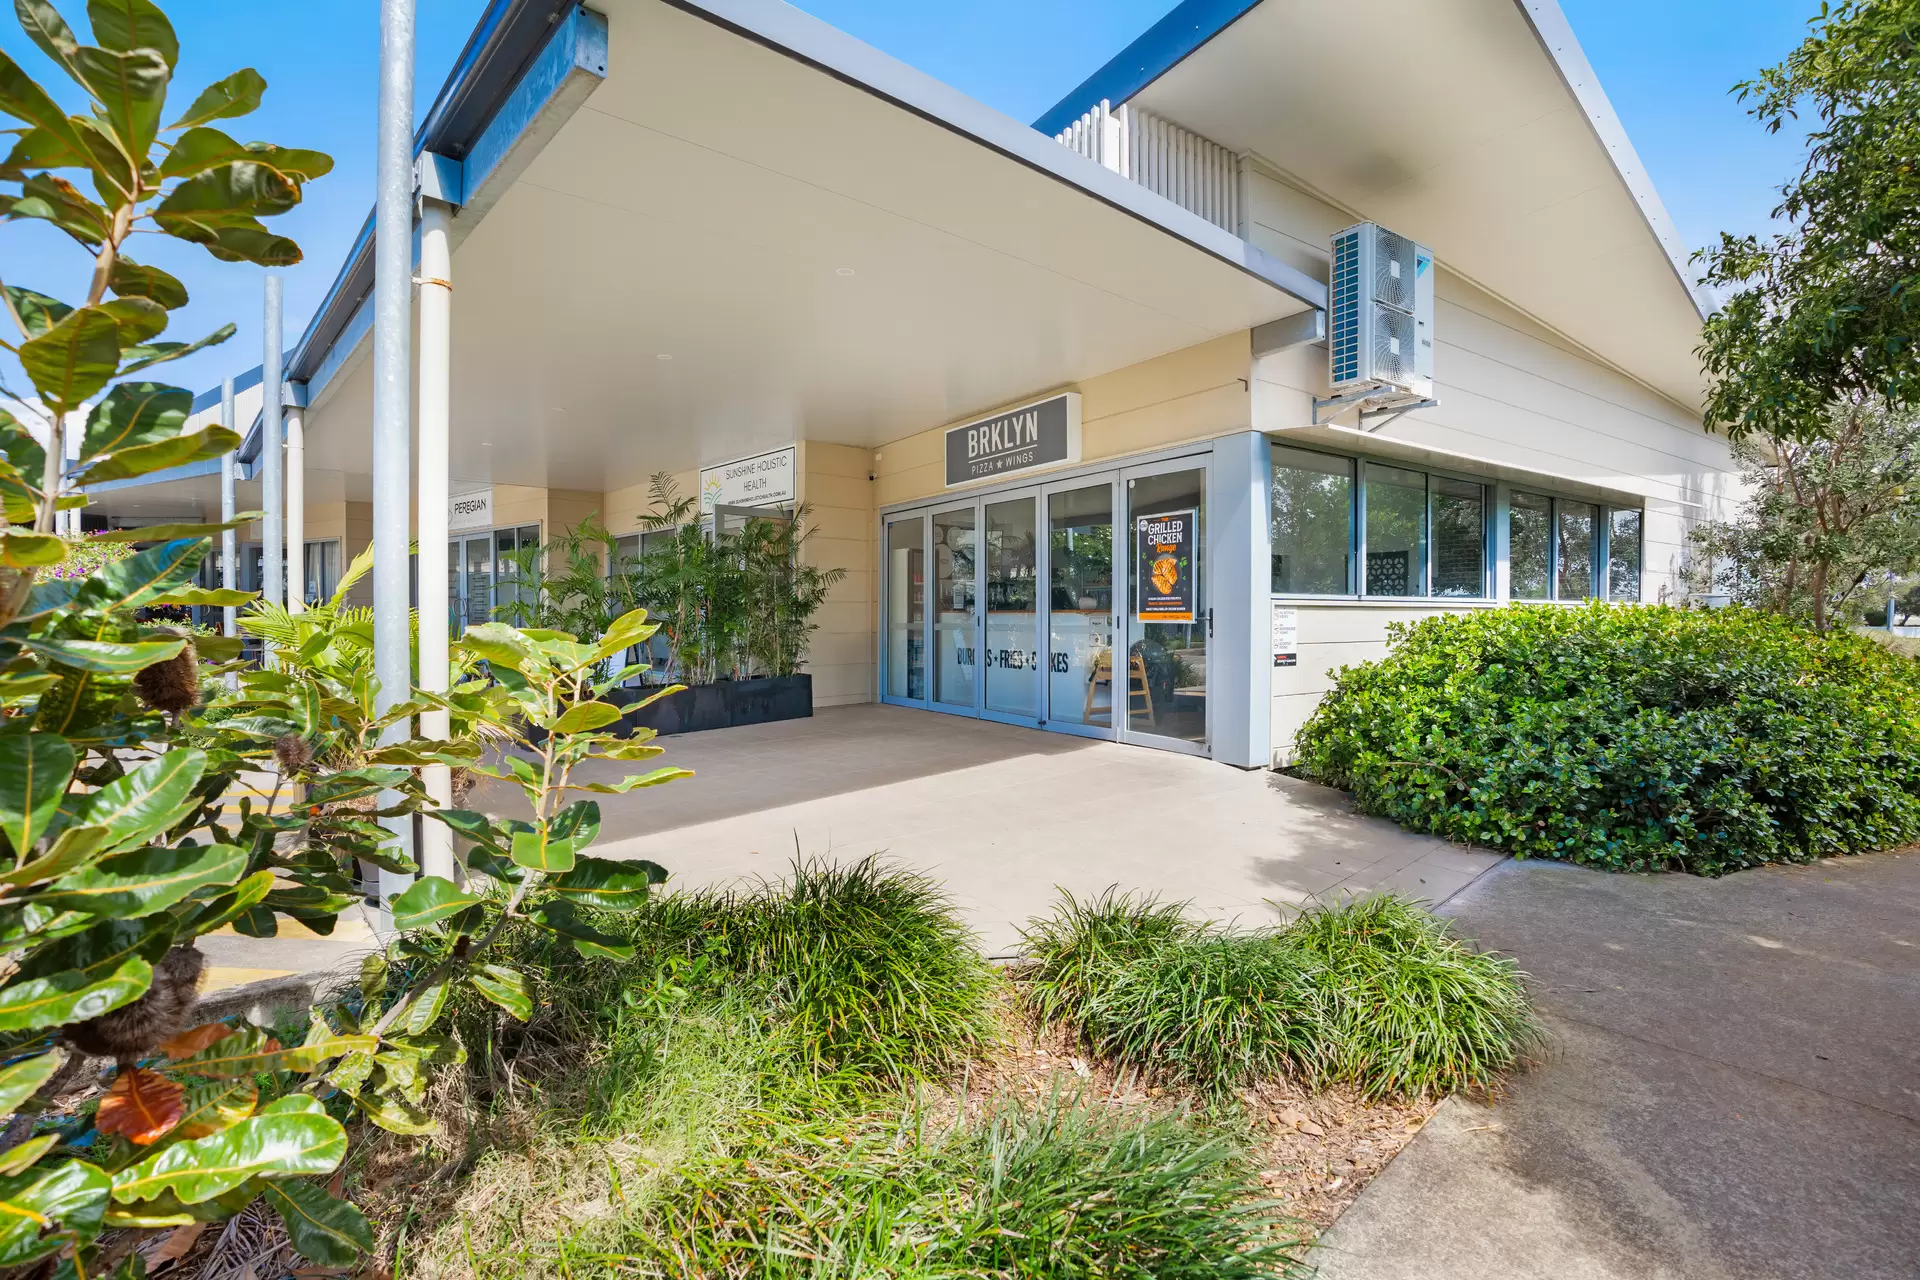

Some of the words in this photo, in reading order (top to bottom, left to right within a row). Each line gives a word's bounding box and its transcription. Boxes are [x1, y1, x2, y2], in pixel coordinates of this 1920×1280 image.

[968, 410, 1038, 458] BRKLYN
[725, 463, 756, 480] SUNSHINE
[757, 455, 788, 472] HOLISTIC
[971, 461, 994, 475] PIZZA
[1005, 451, 1034, 467] WINGS
[743, 477, 767, 492] HEALTH
[454, 499, 487, 514] PEREGIAN
[1148, 520, 1183, 535] GRILLED
[1147, 531, 1183, 546] CHICKEN
[999, 649, 1023, 670] FRIES
